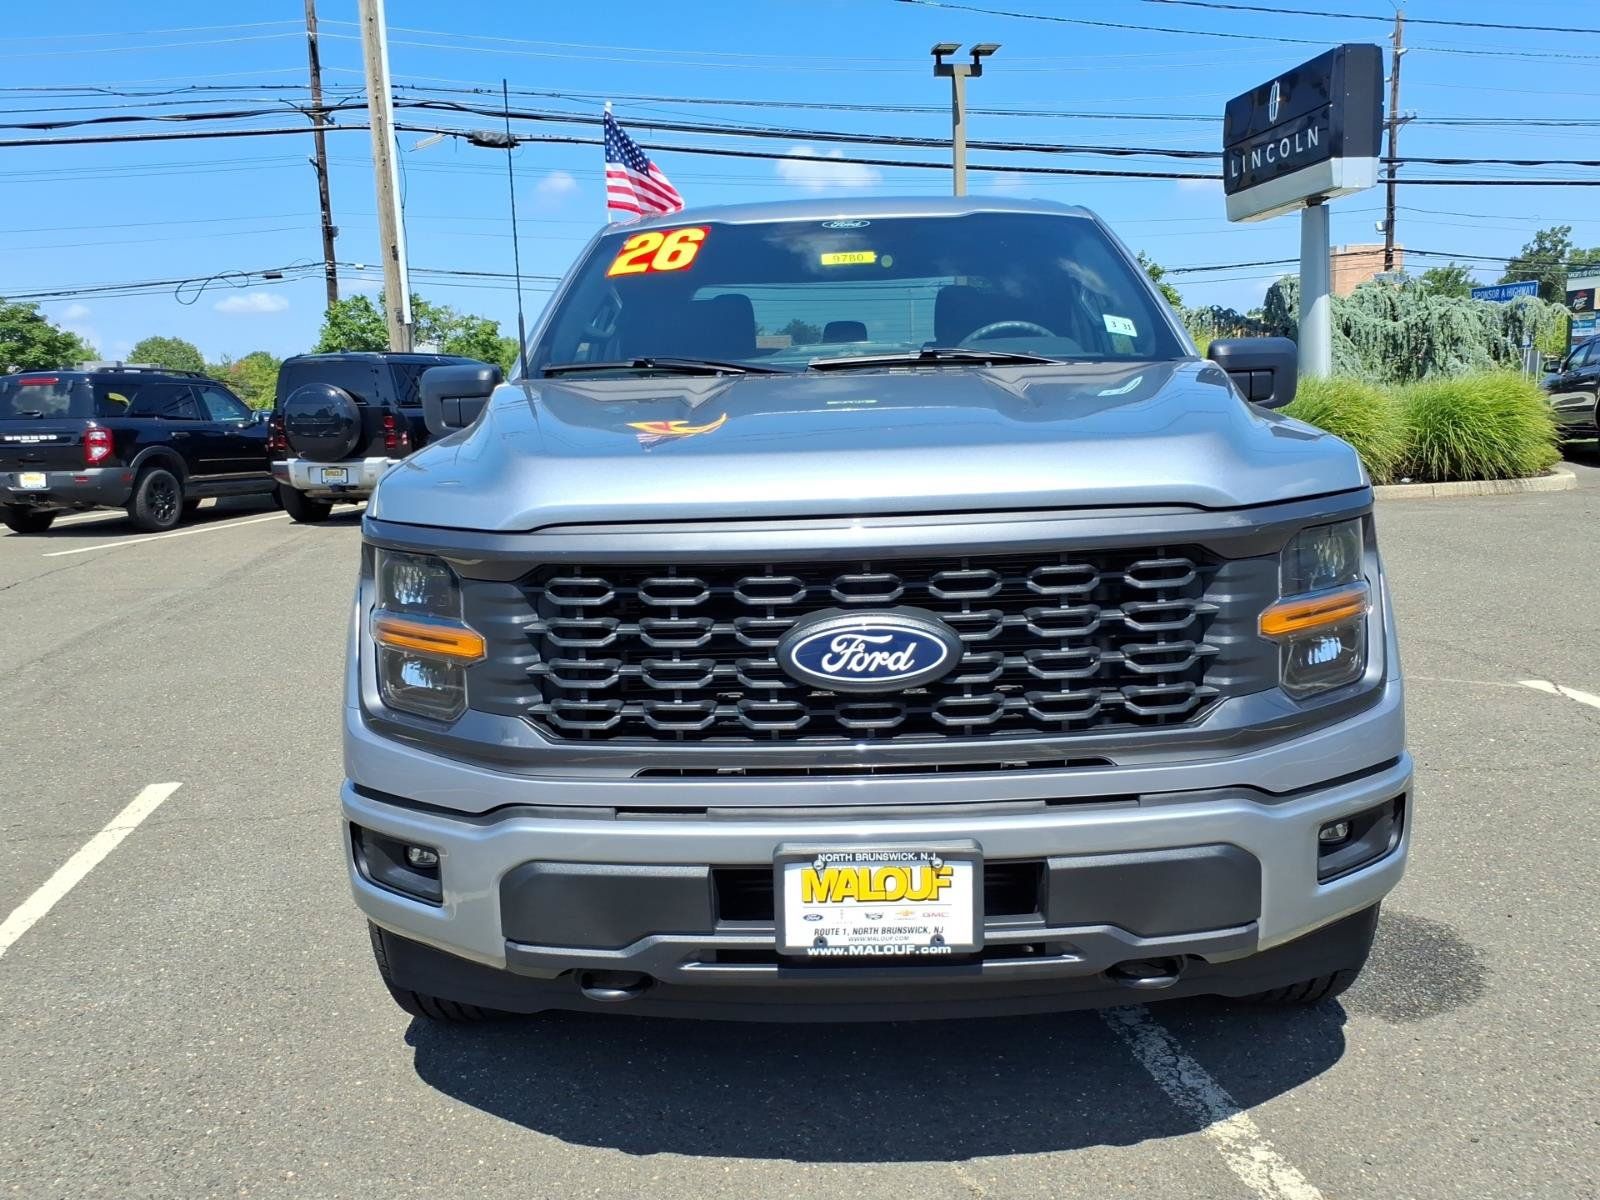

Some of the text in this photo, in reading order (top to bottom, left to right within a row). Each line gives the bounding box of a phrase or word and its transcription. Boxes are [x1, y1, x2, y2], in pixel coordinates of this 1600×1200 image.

[1231, 126, 1319, 178] LINCOLN
[607, 228, 705, 276] 26
[1501, 289, 1506, 299] A
[821, 633, 918, 673] Ford
[818, 853, 853, 862] NORTH
[801, 865, 954, 903] MALOUF
[814, 928, 840, 936] ROUTE
[852, 927, 879, 935] NORTH
[933, 925, 945, 934] NJ
[807, 945, 952, 956] www.MALOUF.com
